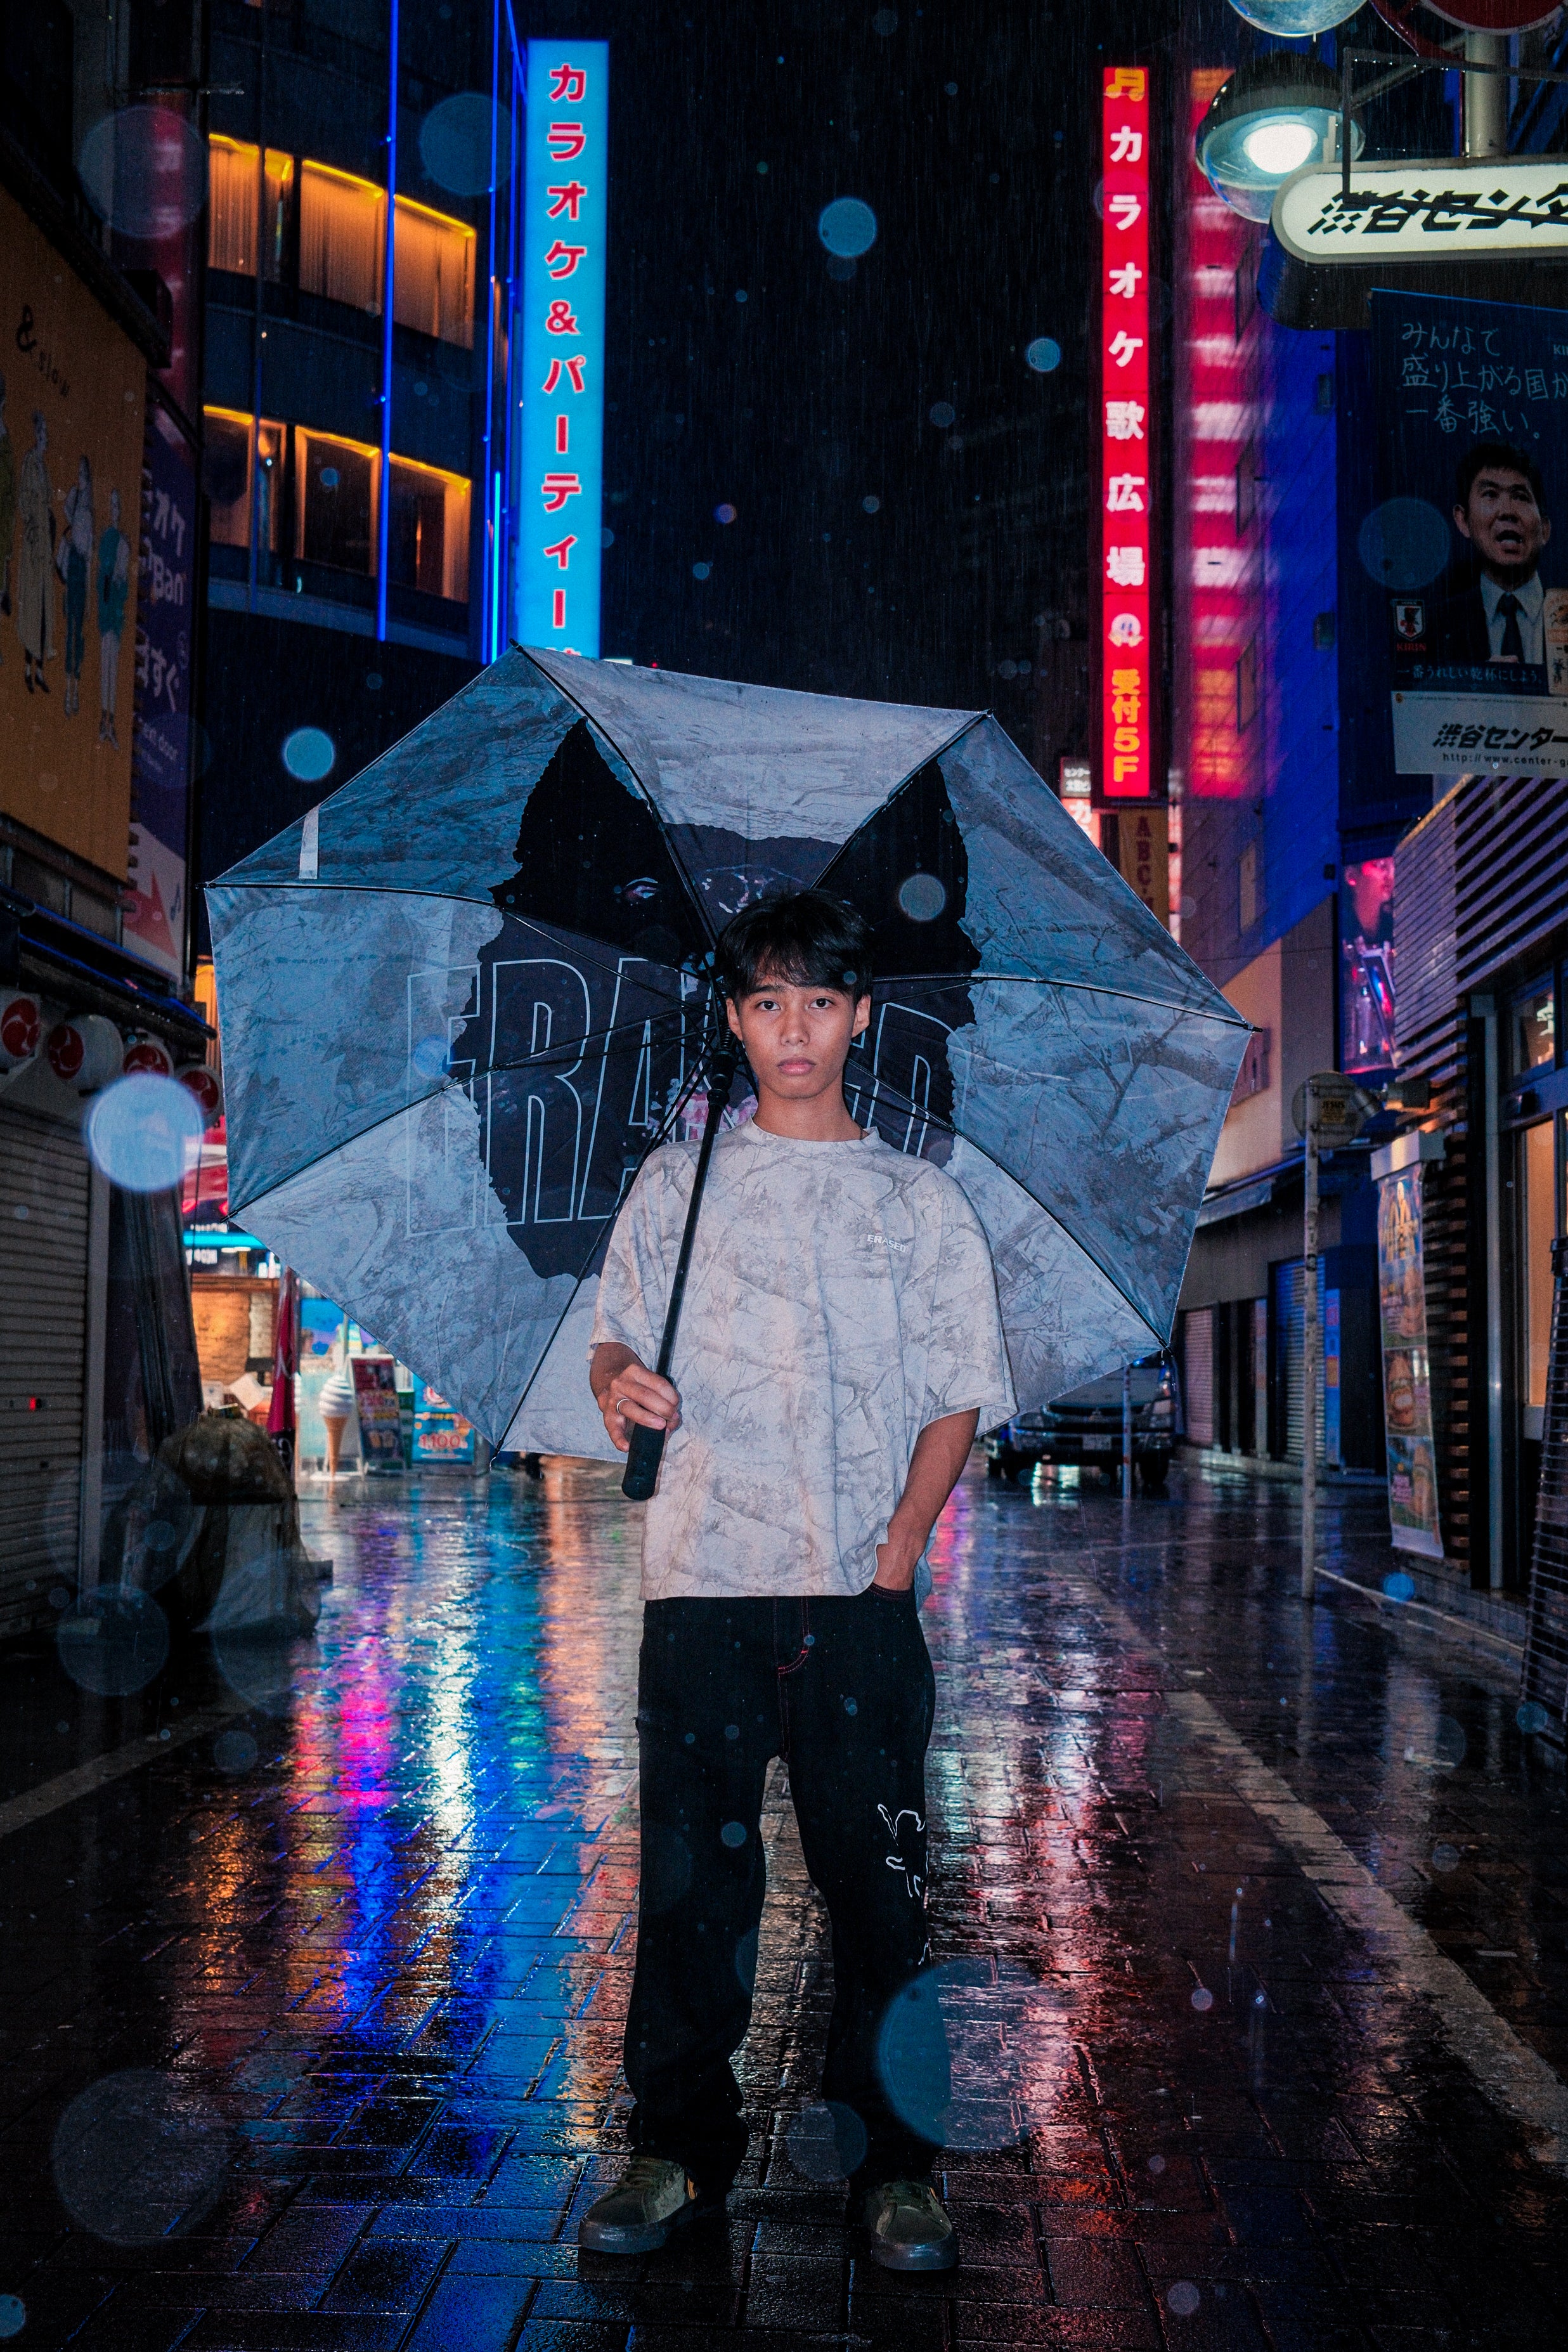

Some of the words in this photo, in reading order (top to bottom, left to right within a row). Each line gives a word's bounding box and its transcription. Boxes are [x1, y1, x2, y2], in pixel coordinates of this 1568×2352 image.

[1401, 322, 1501, 357] みんなで
[541, 63, 588, 656] カラオケ&パーティー
[1105, 126, 1146, 587] カラオケ歌広場
[1406, 394, 1540, 439] 一番強い。
[1396, 642, 1427, 652] KIRIN
[1397, 663, 1543, 684] 一番うれしい乾杯にしよう。
[1111, 668, 1141, 783] 受付5F
[1432, 723, 1568, 751] 渋谷センター
[1442, 753, 1568, 768] http://www.center-g
[867, 1234, 906, 1253] ERASED
